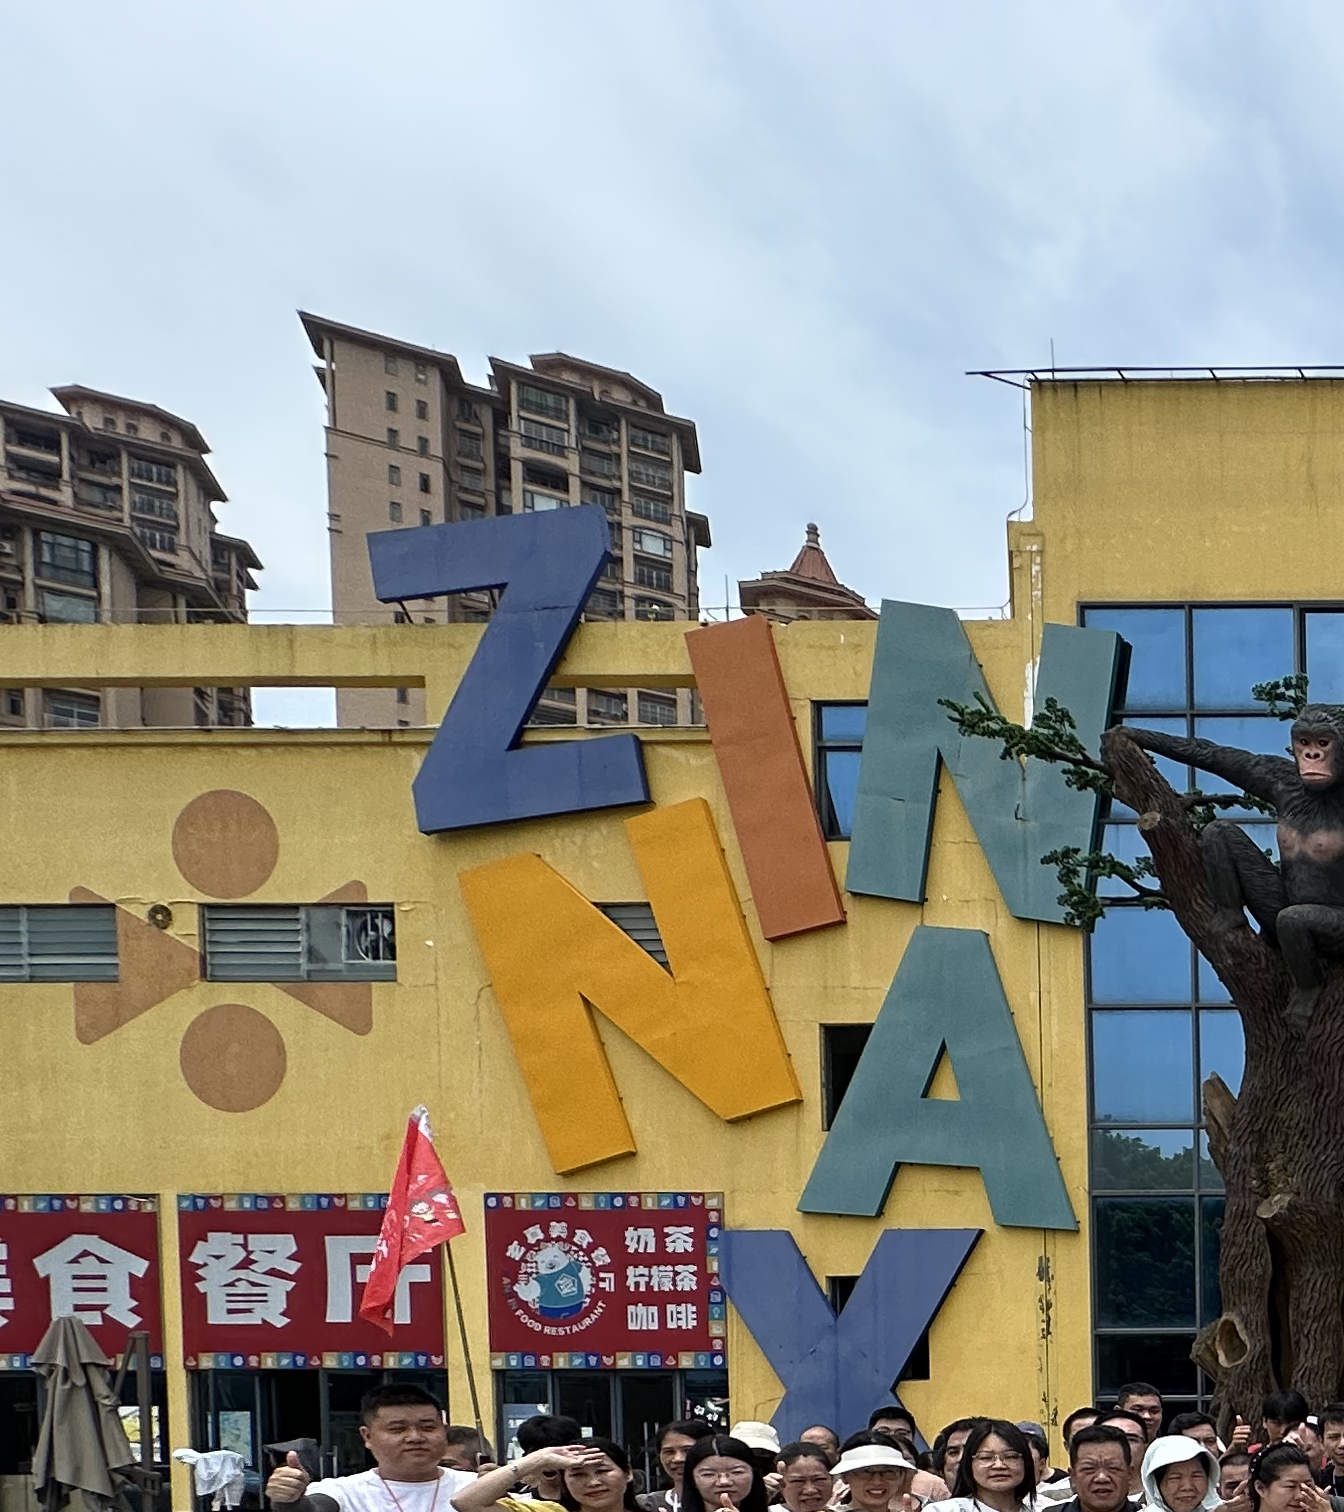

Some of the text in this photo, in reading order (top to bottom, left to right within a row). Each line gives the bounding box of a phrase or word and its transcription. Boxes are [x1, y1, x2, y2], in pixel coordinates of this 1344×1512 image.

[625, 1226, 695, 1253] 奶茶
[0, 1234, 150, 1328] 食
[626, 1264, 698, 1292] 柠檬茶
[515, 1309, 542, 1332] FOOD
[543, 1300, 607, 1336] RESTAURANT
[627, 1303, 698, 1331] 咖啡
